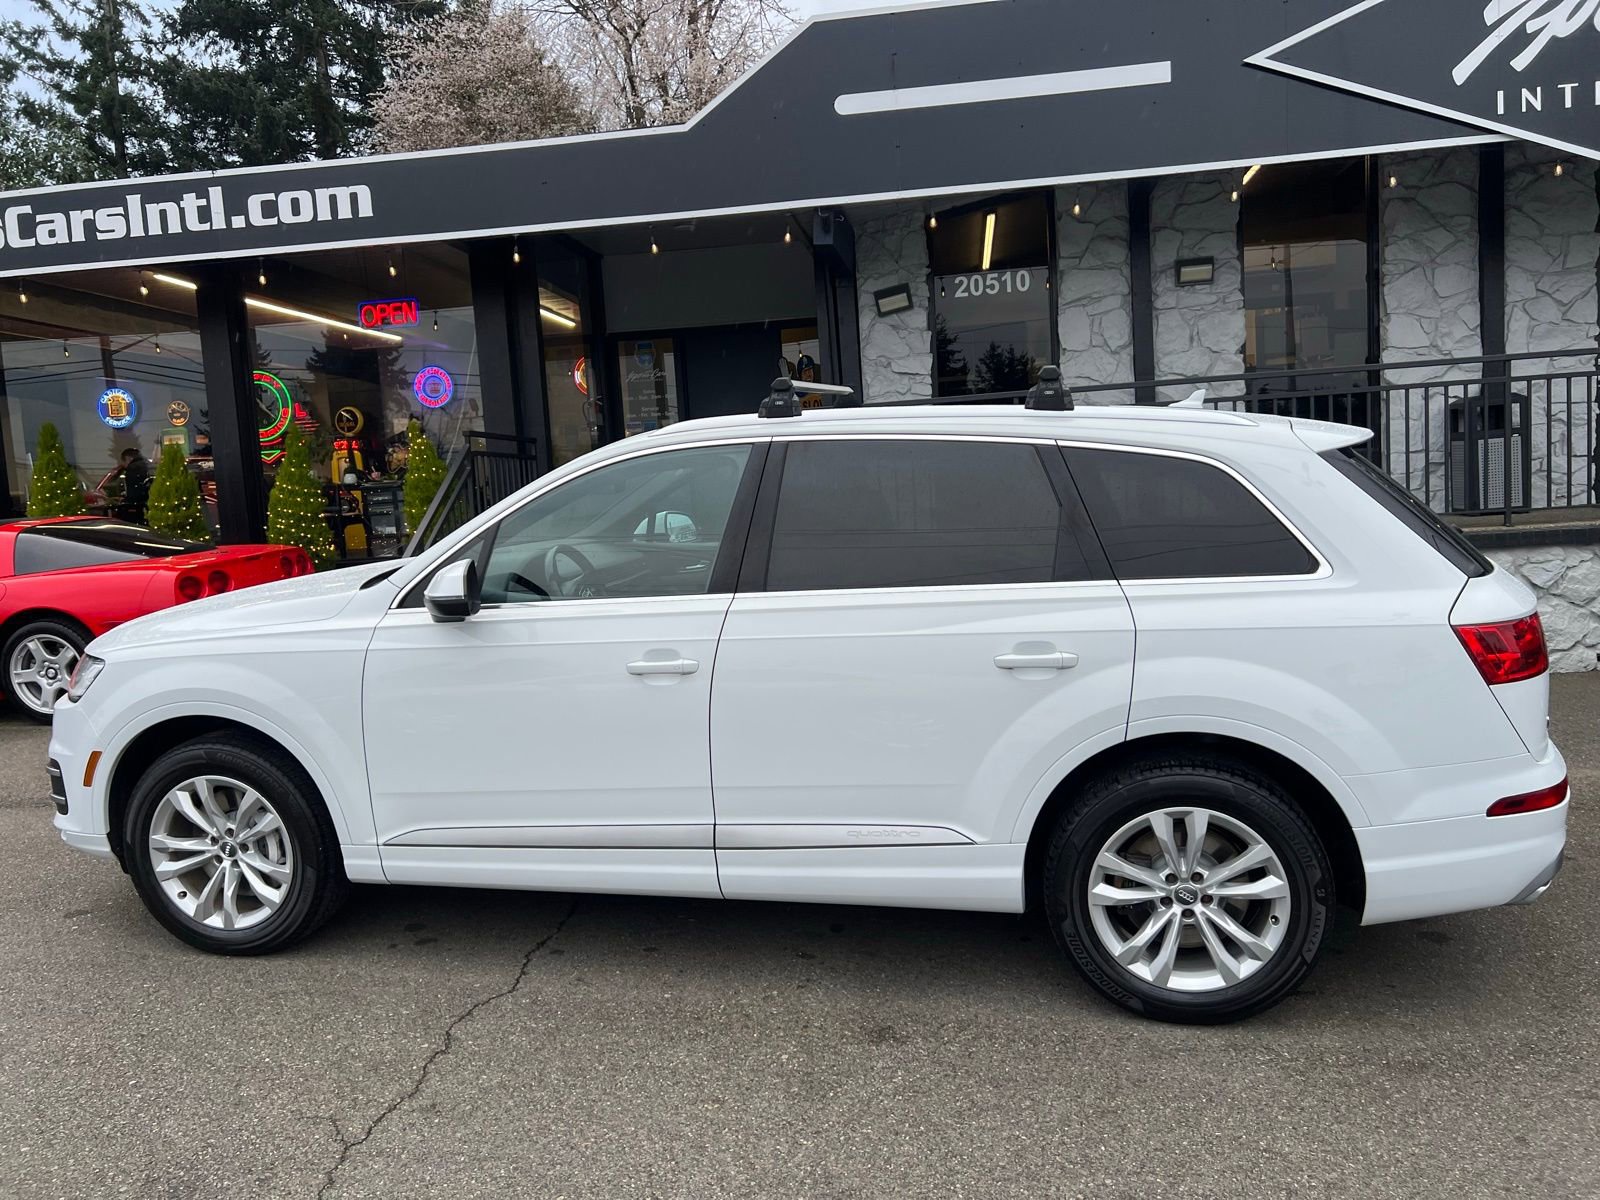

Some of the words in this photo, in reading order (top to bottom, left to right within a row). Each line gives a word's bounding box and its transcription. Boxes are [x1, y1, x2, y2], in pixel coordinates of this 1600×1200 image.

[1496, 80, 1600, 115] INT
[0, 185, 374, 249] CarsIntl.com
[954, 270, 1030, 298] 20510
[361, 301, 417, 328] OPEN
[846, 829, 921, 839] quattro
[1305, 909, 1323, 955] ALENZA
[1064, 930, 1133, 1003] BRIDGESTONE
